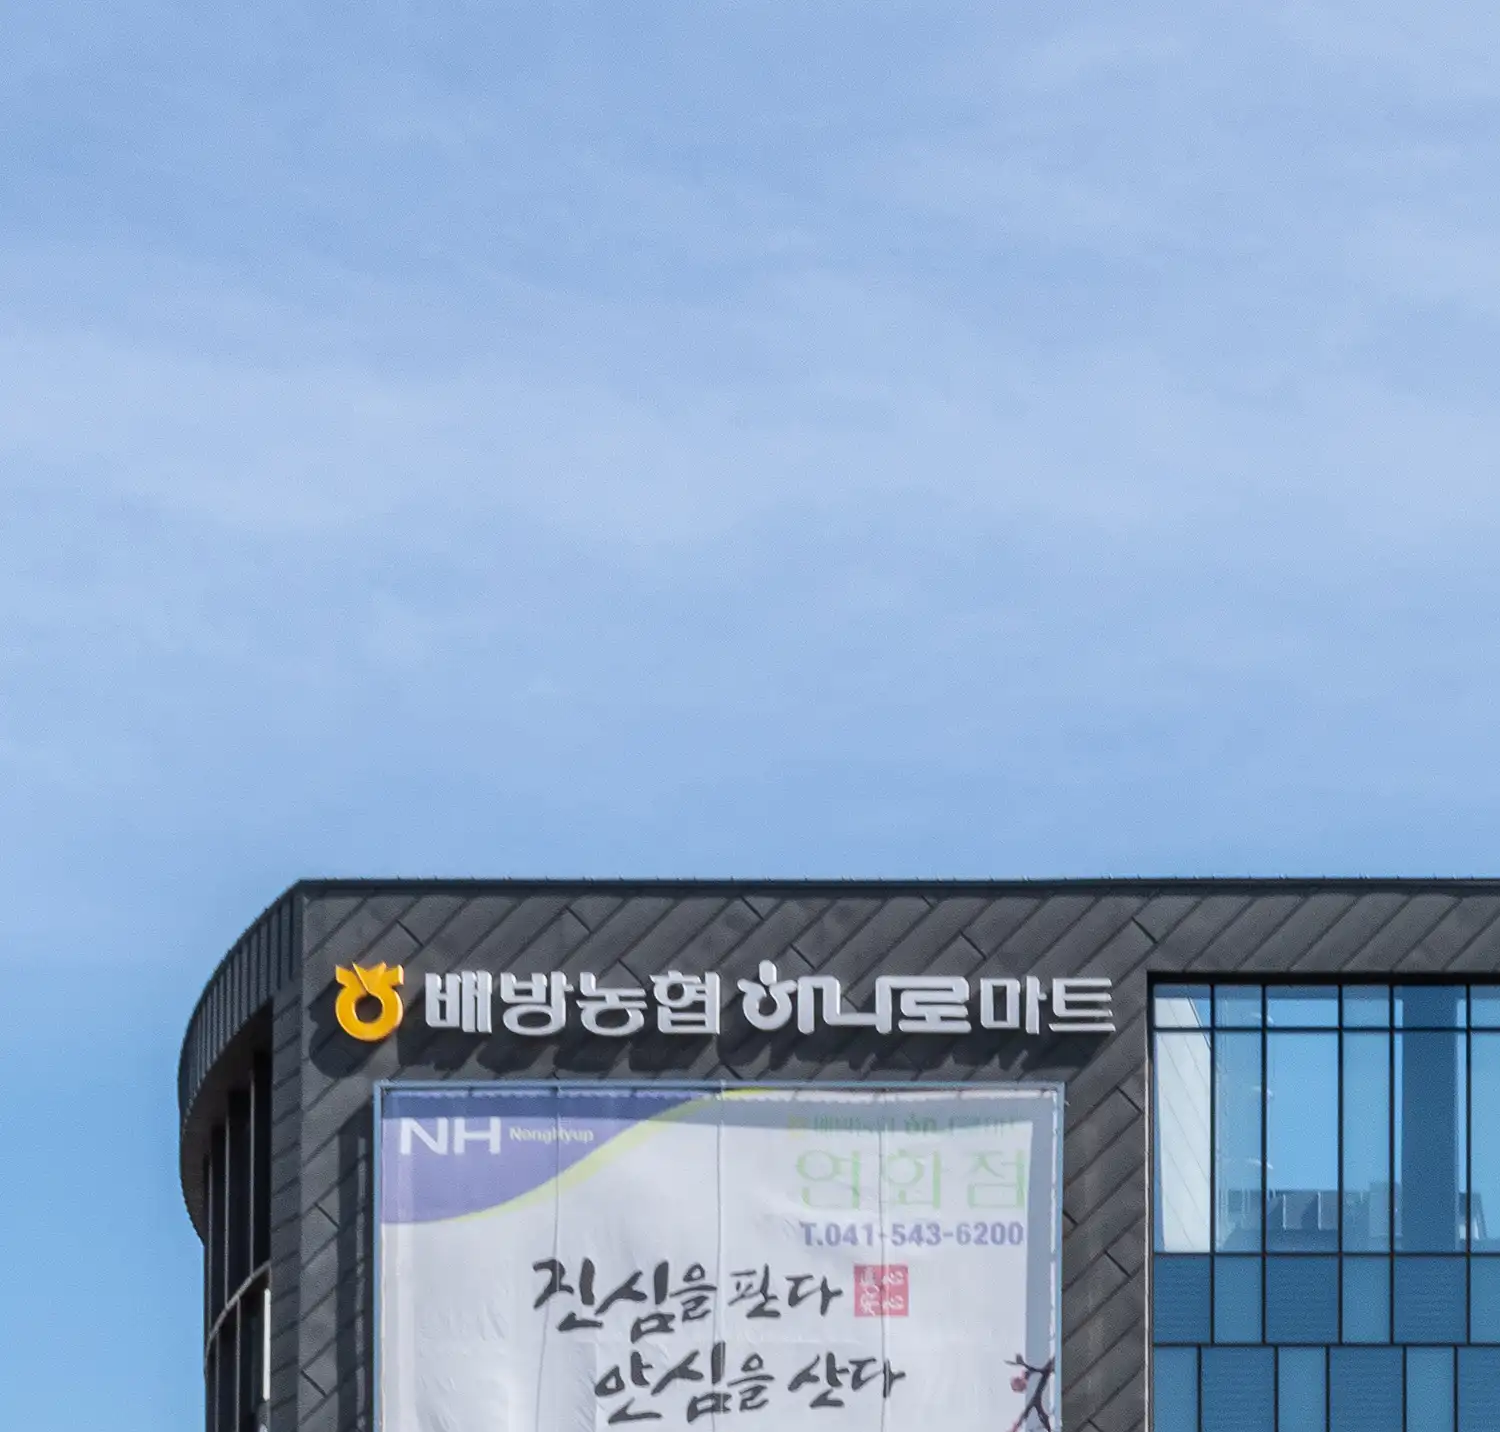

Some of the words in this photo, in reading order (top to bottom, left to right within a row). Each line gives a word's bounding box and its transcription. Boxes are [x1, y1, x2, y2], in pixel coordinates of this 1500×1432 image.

[424, 970, 720, 1036] 배방농협
[738, 960, 1116, 1036] 하나로마트
[399, 1117, 501, 1155] NH
[796, 1148, 1026, 1210] 연화점
[799, 1221, 1025, 1247] T.041-543-6200
[533, 1257, 718, 1343] 진심을
[727, 1263, 844, 1317] 판다
[594, 1341, 776, 1424] 안심을
[787, 1351, 907, 1409] 산다
